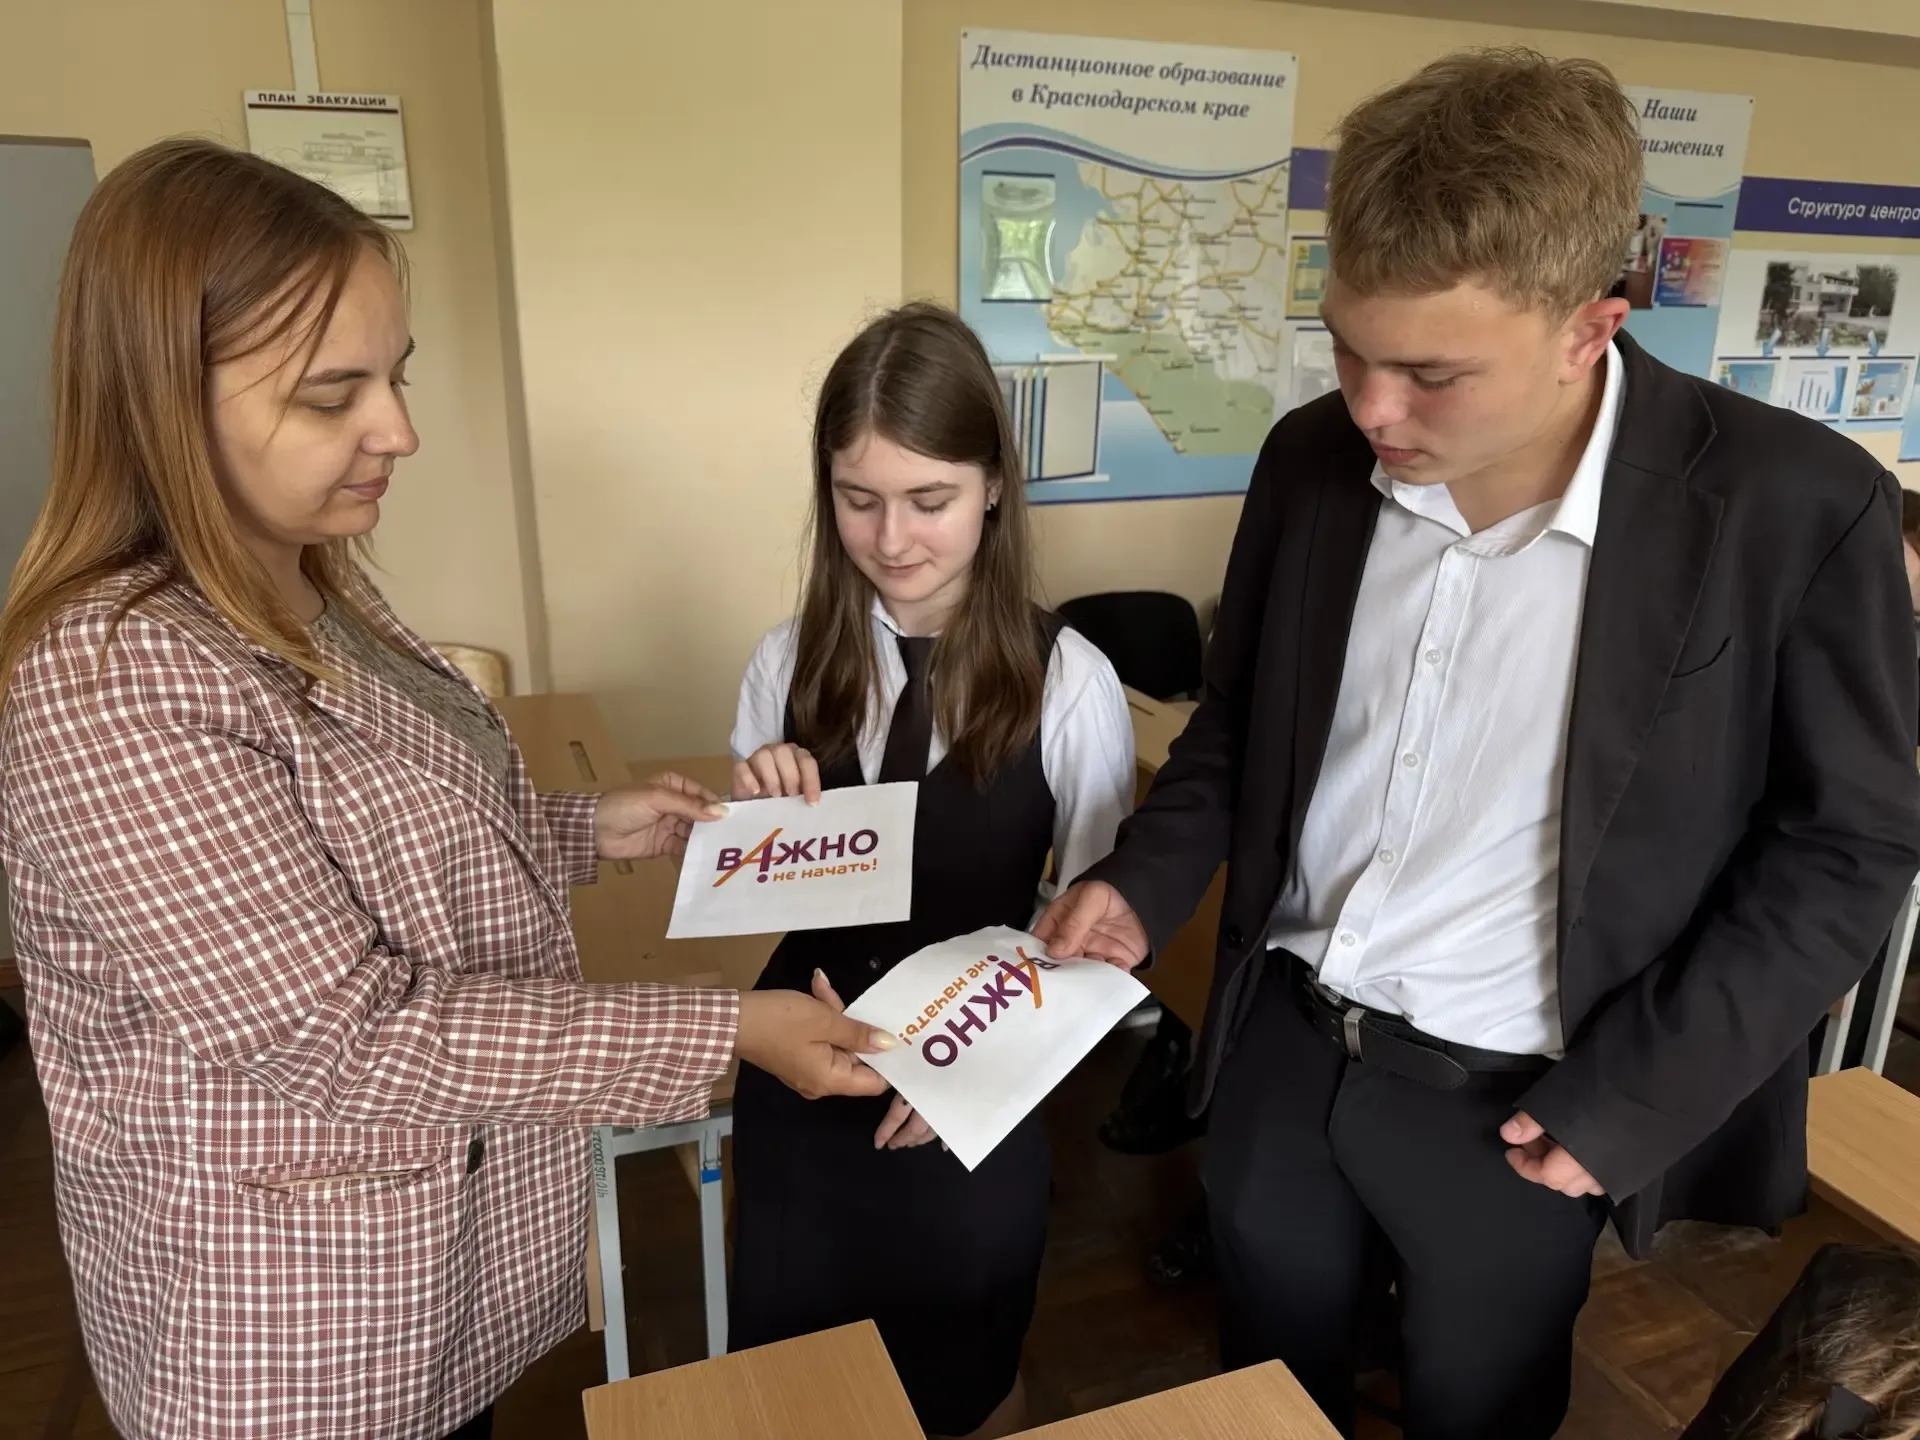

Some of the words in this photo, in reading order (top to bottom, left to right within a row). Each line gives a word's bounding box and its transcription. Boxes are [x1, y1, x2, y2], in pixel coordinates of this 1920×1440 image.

[970, 44, 1154, 79] Дистанционное
[1159, 62, 1286, 88] образование
[258, 93, 296, 103] ПЛАН
[307, 95, 387, 106] ЭВАКУАЦИИ
[1011, 86, 1024, 103] в
[1029, 83, 1197, 115] Краснодарском
[1202, 100, 1250, 120] крае
[1642, 98, 1698, 122] Наши
[1788, 196, 1867, 220] Структура
[1870, 204, 1920, 223] центра
[773, 871, 796, 882] не
[801, 858, 878, 880] начать!
[965, 960, 989, 980] не
[898, 976, 969, 1045] начать!
